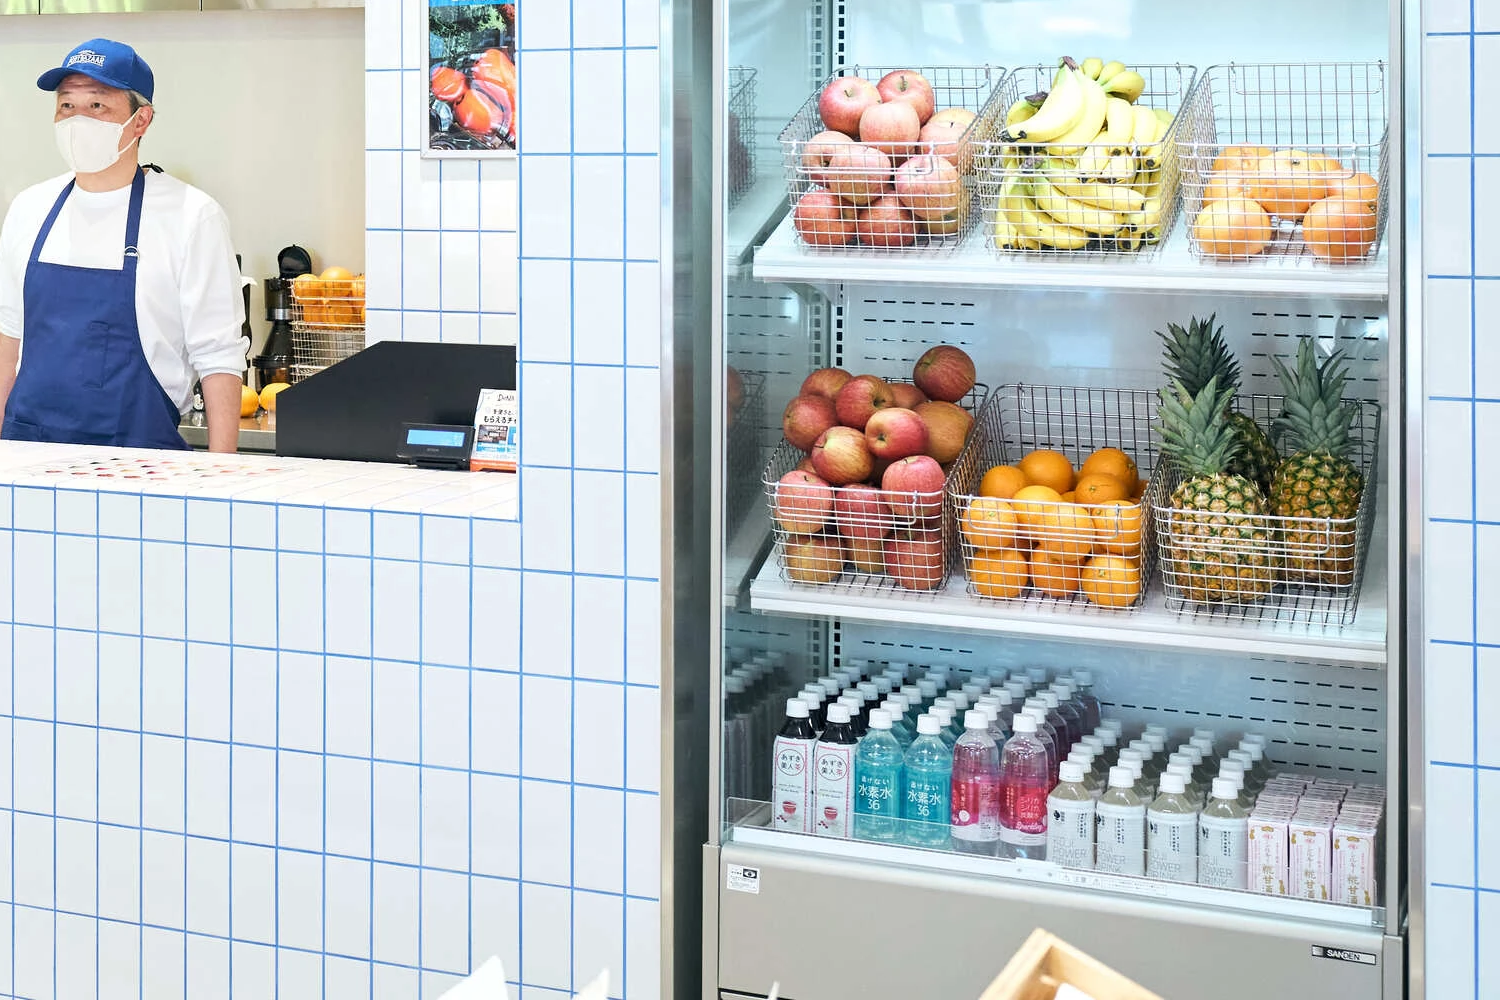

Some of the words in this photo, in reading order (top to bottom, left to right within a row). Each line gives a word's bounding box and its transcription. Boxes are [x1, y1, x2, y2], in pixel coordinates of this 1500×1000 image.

[858, 784, 893, 799] 水素水
[907, 789, 941, 806] 水素水
[867, 799, 880, 810] 36
[917, 804, 930, 816] 36
